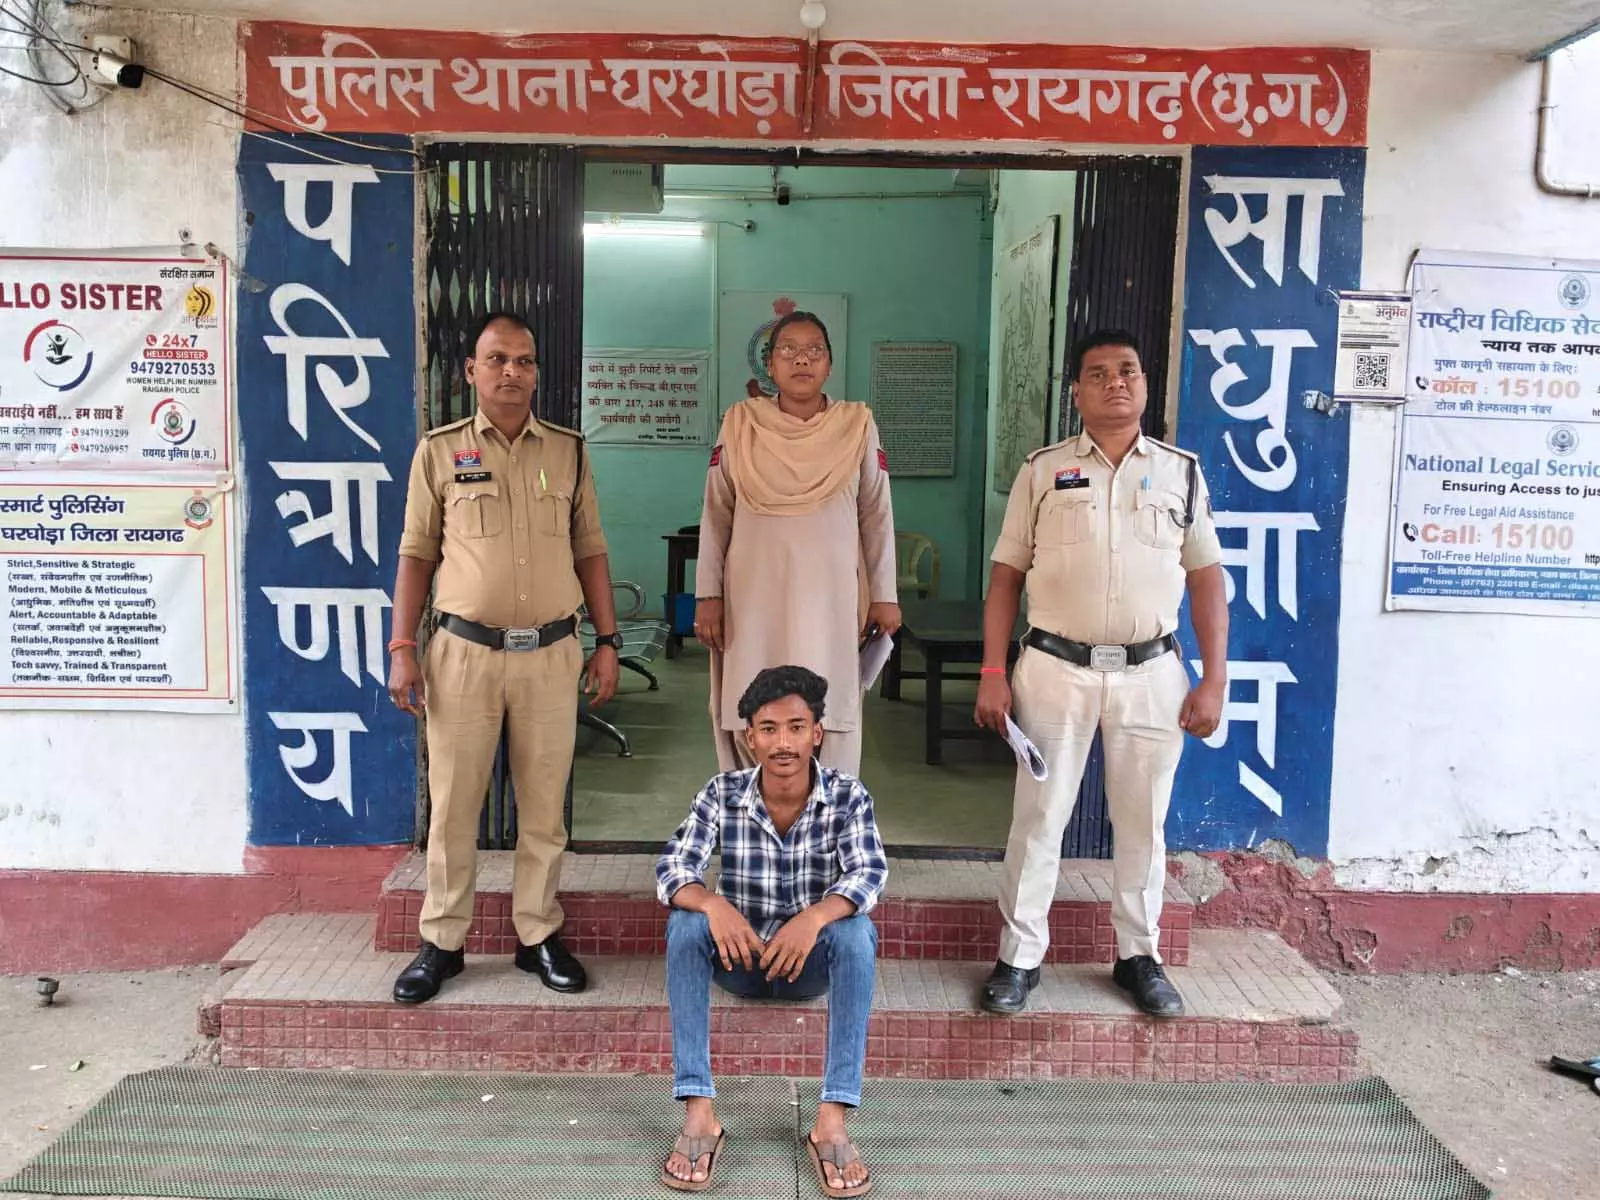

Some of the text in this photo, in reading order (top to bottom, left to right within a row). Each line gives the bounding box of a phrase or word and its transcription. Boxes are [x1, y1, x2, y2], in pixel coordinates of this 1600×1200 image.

[268, 32, 442, 132] पुलिस
[61, 283, 162, 311] SISTER
[1416, 308, 1484, 333] राष्ट्रीय
[1491, 308, 1565, 334] विधिक
[162, 334, 198, 347] 24x7
[1480, 340, 1522, 353] न्याय
[1527, 342, 1556, 355] तक
[146, 351, 173, 359] HELLO
[130, 361, 216, 375] 9479270533
[1461, 359, 1492, 373] कानूनी
[1498, 361, 1535, 373] सहायता
[1540, 362, 1549, 373] के
[126, 377, 152, 385] WOMEN
[154, 378, 187, 386] HELPLINE
[1432, 376, 1477, 395] कॉल
[1497, 376, 1582, 399] 15100
[1435, 399, 1456, 412] टोल
[76, 408, 91, 420] हम
[167, 447, 189, 460] पुलिस
[1405, 454, 1484, 473] National
[1490, 457, 1540, 479] Legal
[1442, 480, 1506, 495] Ensuring
[1510, 483, 1561, 495] Access
[1566, 485, 1580, 496] to
[0, 494, 124, 519] स्मार्ट पुलिसिंग
[1424, 504, 1575, 520] For Free Legal Aid Assistance
[70, 523, 118, 542] जिला
[1492, 523, 1573, 550] 15100
[1421, 549, 1571, 565] Toll-Free Helpline Number
[81, 560, 89, 568] &
[91, 560, 135, 570] Strategic
[1423, 577, 1453, 585] Phone
[8, 585, 147, 594] Modern, Mobile & Meticulous
[9, 611, 157, 620] Alert, Accountable & Adaptable
[107, 637, 115, 645] &
[117, 637, 159, 645] Resilient
[12, 661, 33, 669] Tech
[64, 662, 98, 670] Trained
[101, 662, 108, 670] &
[111, 662, 167, 671] Transparent
